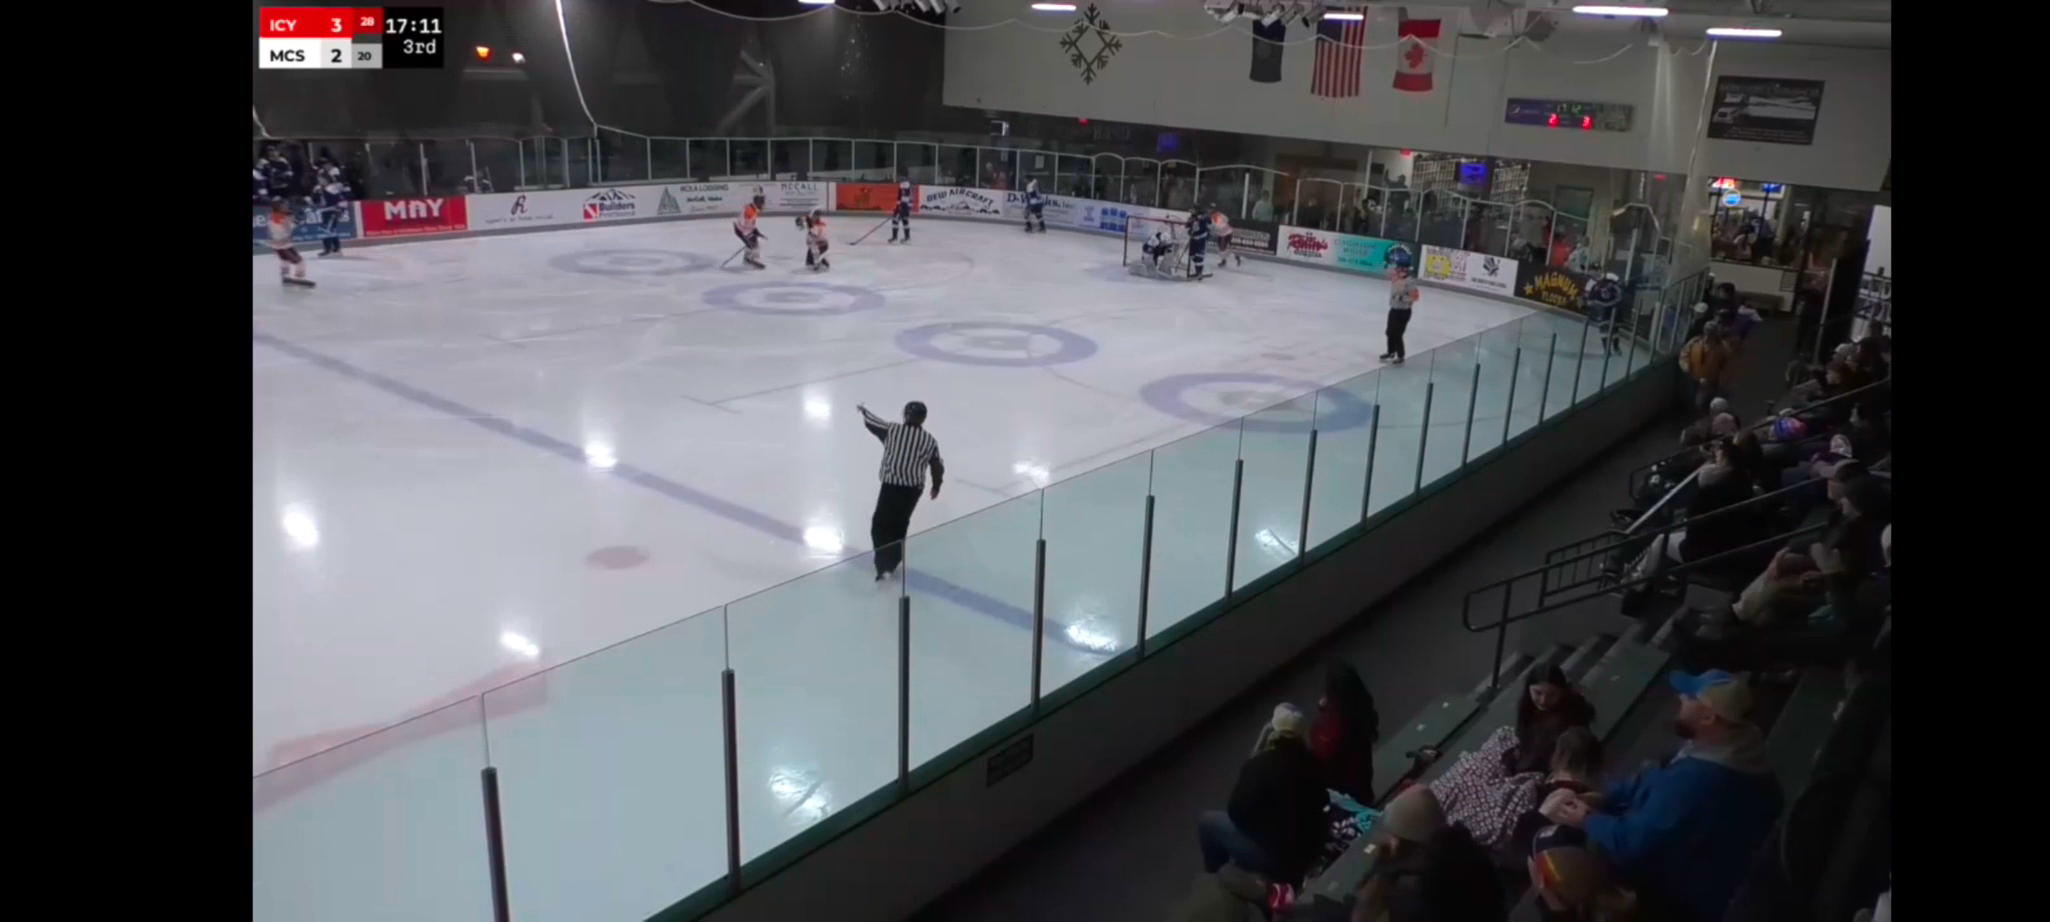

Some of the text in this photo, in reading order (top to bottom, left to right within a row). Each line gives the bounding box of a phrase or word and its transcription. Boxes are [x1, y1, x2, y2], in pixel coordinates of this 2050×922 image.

[599, 201, 636, 212] Builders
[949, 187, 995, 206] AIRCRAFT
[384, 197, 444, 221] MAY
[1534, 271, 1580, 296] MAGNUM
